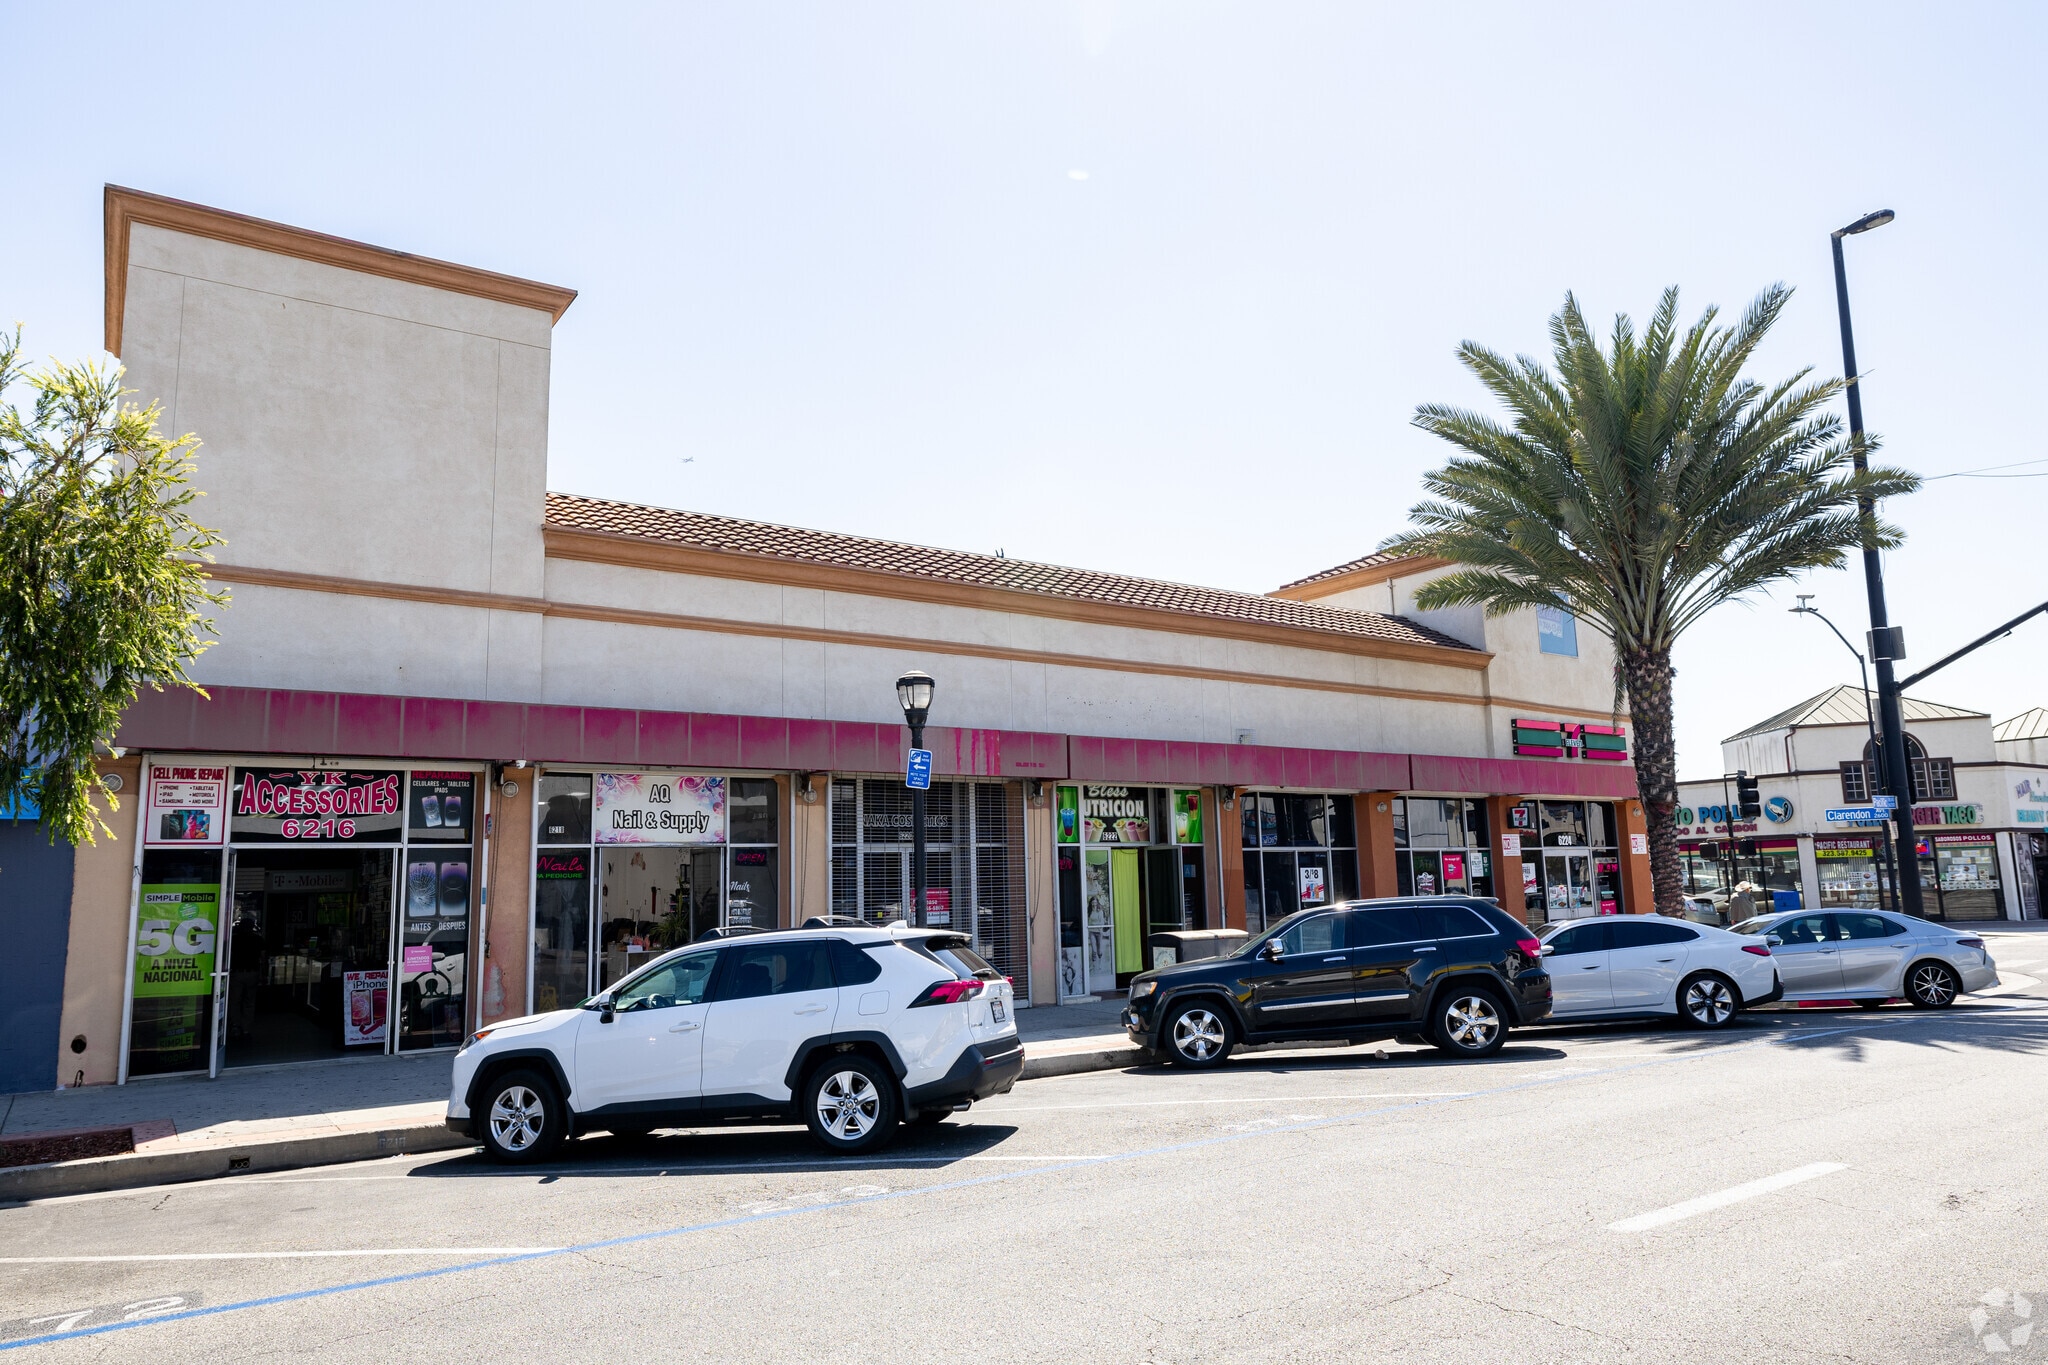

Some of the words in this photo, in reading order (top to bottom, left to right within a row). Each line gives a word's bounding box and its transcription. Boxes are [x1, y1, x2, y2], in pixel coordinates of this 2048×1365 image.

[153, 767, 171, 779] CELL
[172, 768, 197, 780] PHONE
[198, 768, 225, 781] REPAIR
[238, 772, 399, 815] ACCESSORIES
[648, 784, 672, 803] AQ
[1087, 784, 1129, 797] Bless
[2014, 780, 2031, 799] HAIR
[1083, 799, 1145, 818] UTRICION
[1674, 807, 1693, 825] TO
[1698, 804, 1757, 824] POLL
[1827, 809, 1871, 820] Clarendon
[1942, 805, 1977, 825] TACO
[613, 810, 643, 829] Nail
[645, 811, 657, 829] &
[660, 810, 710, 834] Supply
[891, 814, 948, 827] COSTICS
[2016, 809, 2045, 823] BEAUTY
[281, 819, 356, 839] 6216
[1696, 827, 1709, 835] AL
[1714, 823, 1758, 834] CABON
[1557, 835, 1573, 846] 6224
[1816, 841, 1837, 850] PACIFIC
[1837, 840, 1871, 849] RESTAURANT
[536, 856, 585, 871] Nails
[737, 853, 765, 862] OPEN
[1058, 859, 1074, 870] PEN
[299, 874, 339, 886] Mobile
[730, 881, 750, 893] Nails
[146, 894, 180, 902] SIMPLE
[182, 894, 214, 902] Mobile
[411, 923, 432, 931] ANTES
[438, 921, 466, 931] DESPUES
[137, 918, 214, 956] 5G
[151, 959, 160, 970] A
[163, 958, 199, 970] NIVEL
[143, 970, 205, 983] NACIONAL
[346, 973, 360, 981] WE
[364, 971, 388, 980] REPAI
[353, 980, 387, 989] iPhone
